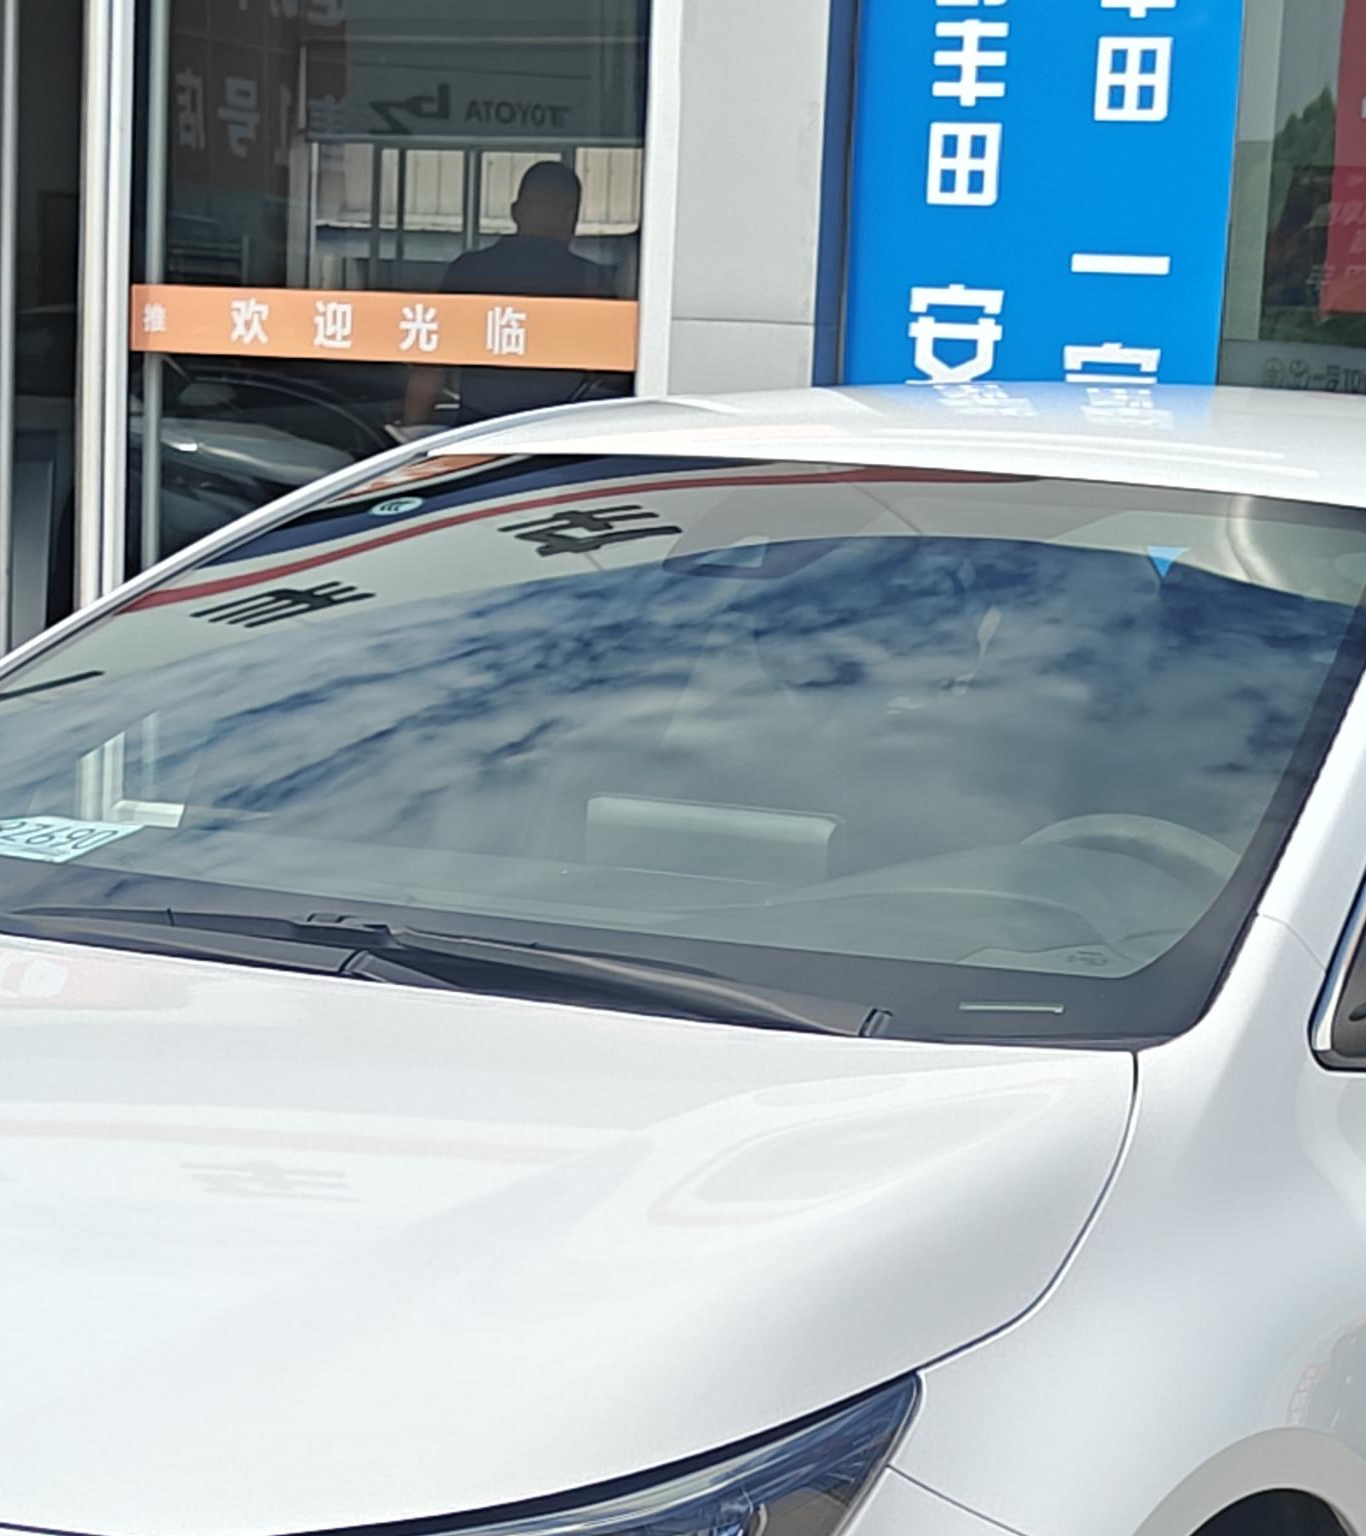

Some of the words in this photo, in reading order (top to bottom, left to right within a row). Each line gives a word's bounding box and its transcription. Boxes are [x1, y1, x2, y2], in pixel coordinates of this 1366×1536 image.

[925, 0, 1011, 207] 丰田
[1093, 0, 1177, 122] 田
[142, 302, 167, 333] 推
[229, 297, 527, 356] 欢迎光临
